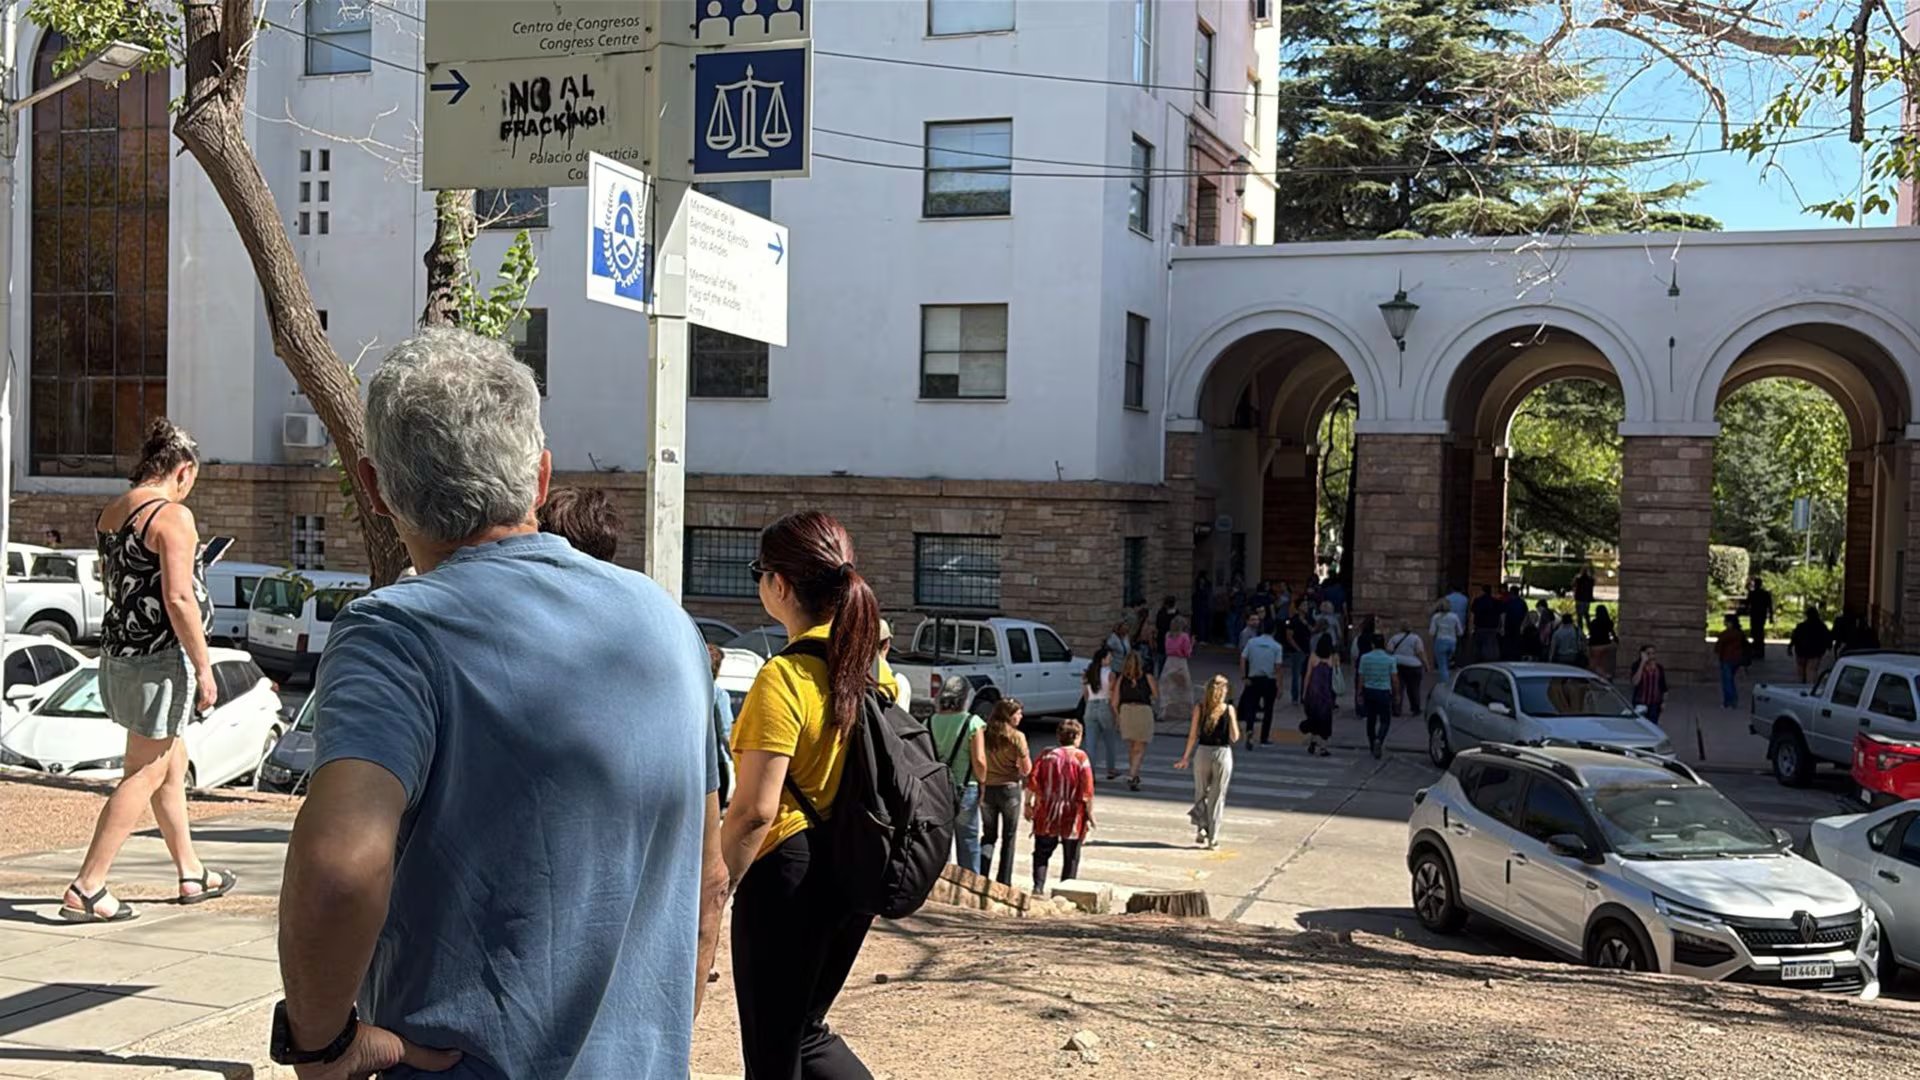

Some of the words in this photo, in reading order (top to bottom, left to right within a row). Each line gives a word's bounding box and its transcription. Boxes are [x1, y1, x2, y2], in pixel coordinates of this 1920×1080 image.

[512, 21, 553, 34] Centro
[556, 19, 573, 31] de
[576, 16, 640, 31] Congresos
[540, 37, 594, 52] Congress
[598, 34, 640, 47] Centre
[560, 73, 595, 101] AL
[529, 151, 572, 164] Palacio
[597, 147, 639, 161] usticia
